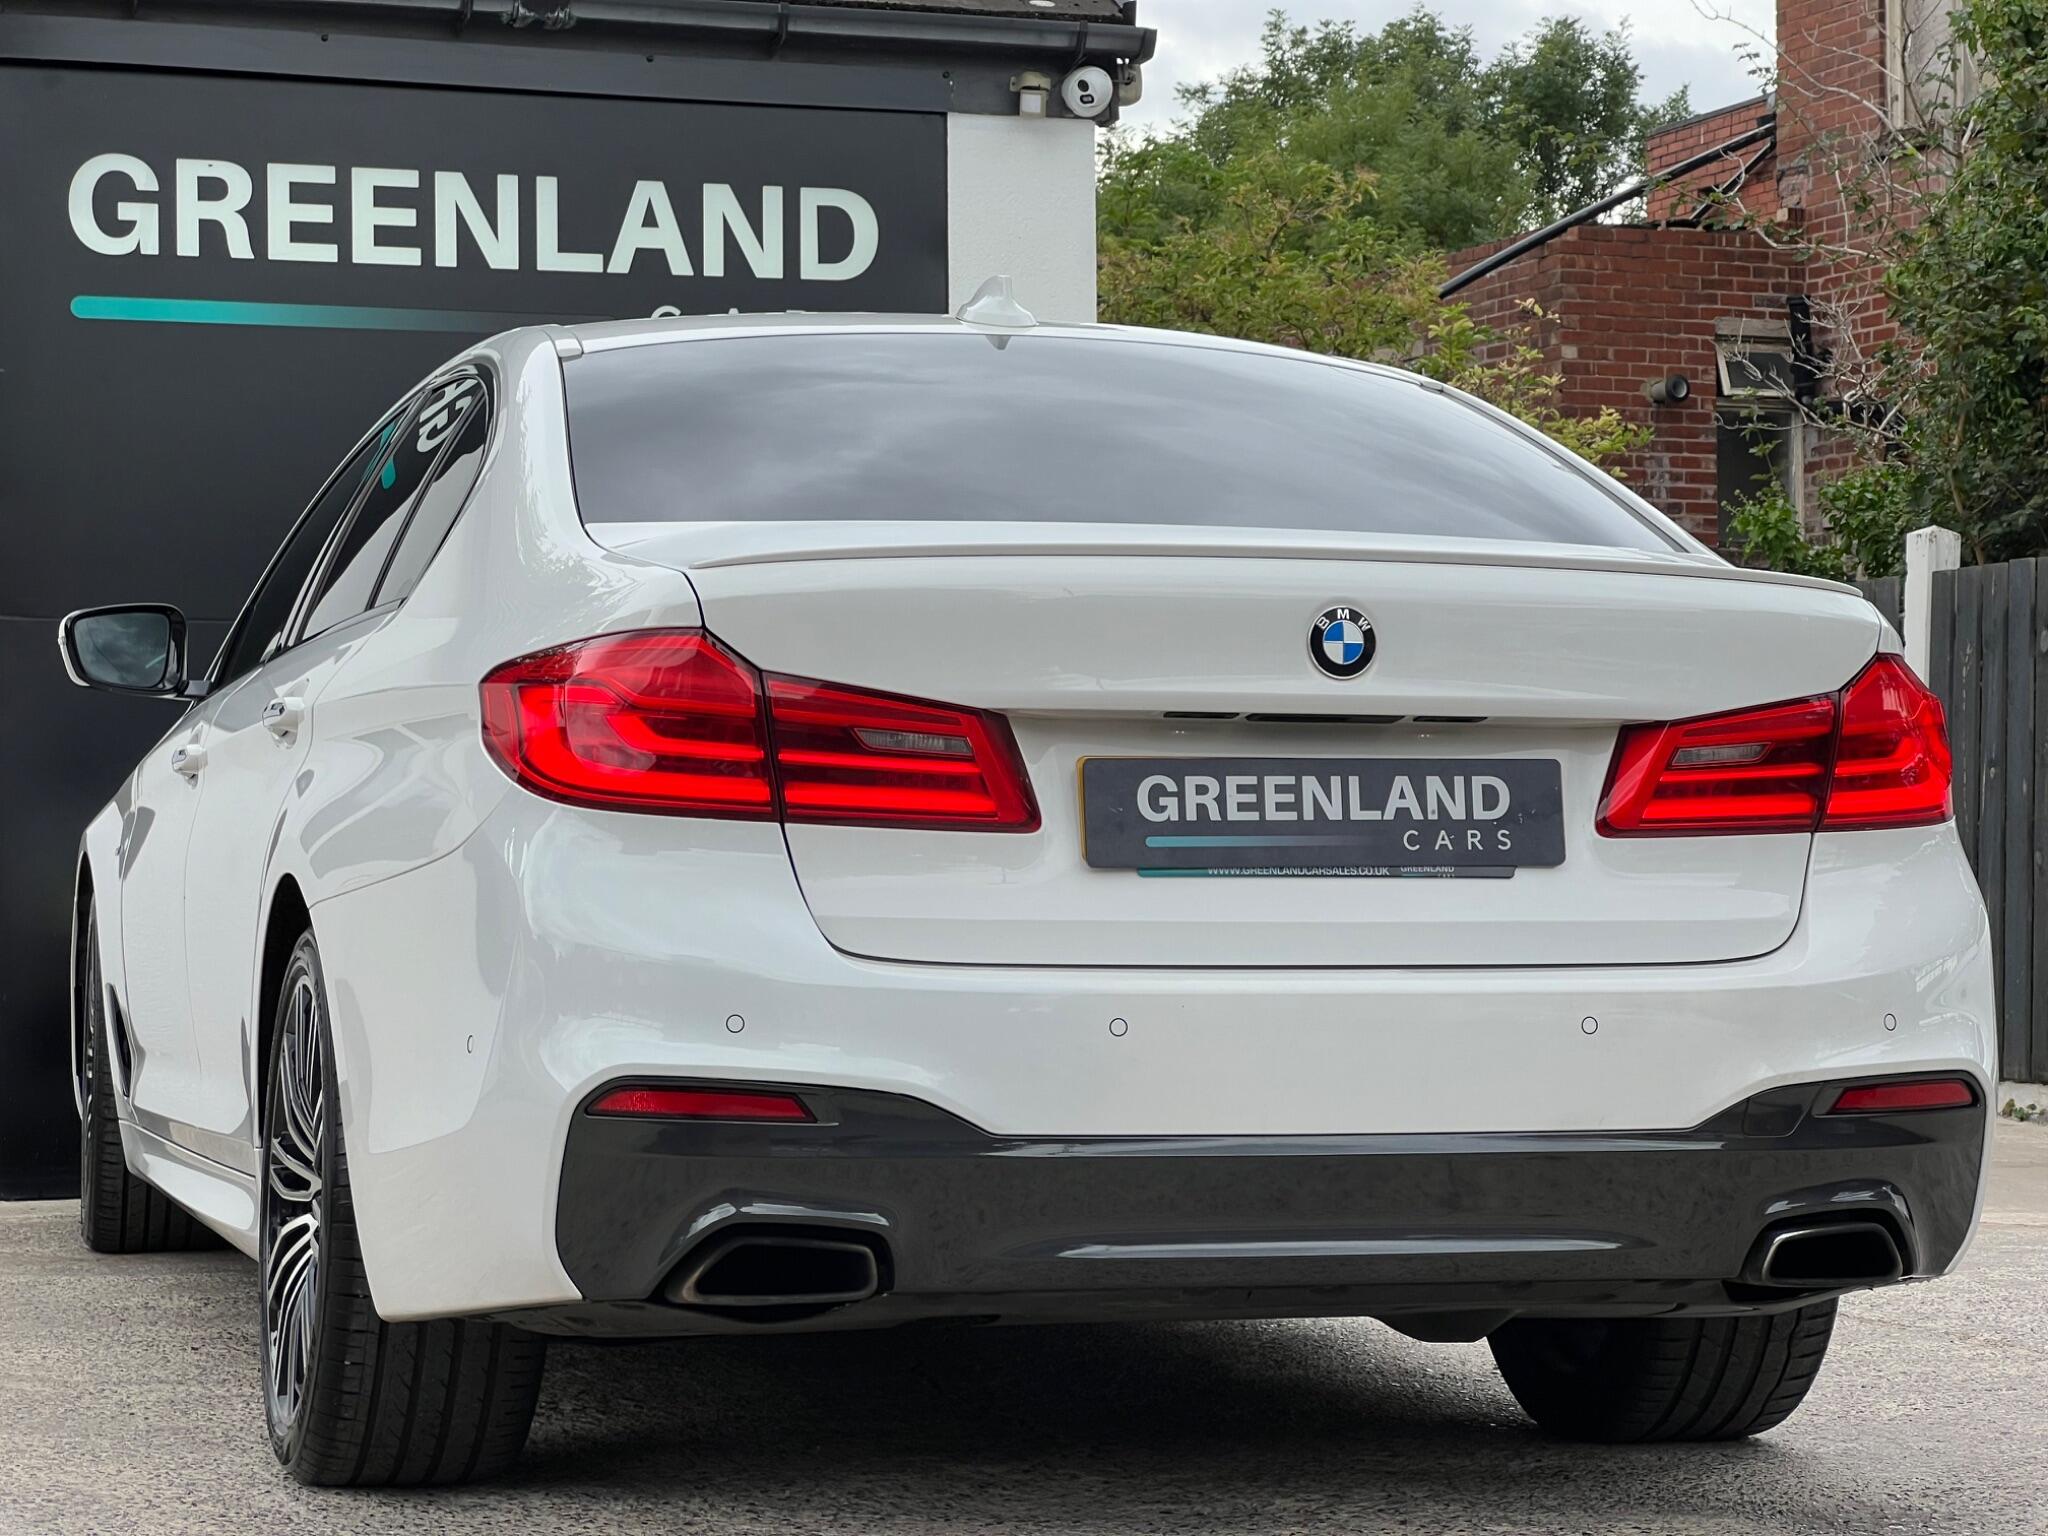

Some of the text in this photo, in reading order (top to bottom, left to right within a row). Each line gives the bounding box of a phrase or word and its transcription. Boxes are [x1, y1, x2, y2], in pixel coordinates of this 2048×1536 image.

[68, 153, 880, 281] GREENLAND
[1316, 608, 1371, 631] BMW
[1136, 774, 1511, 821] GREENLAND
[1403, 830, 1511, 851] CARS
